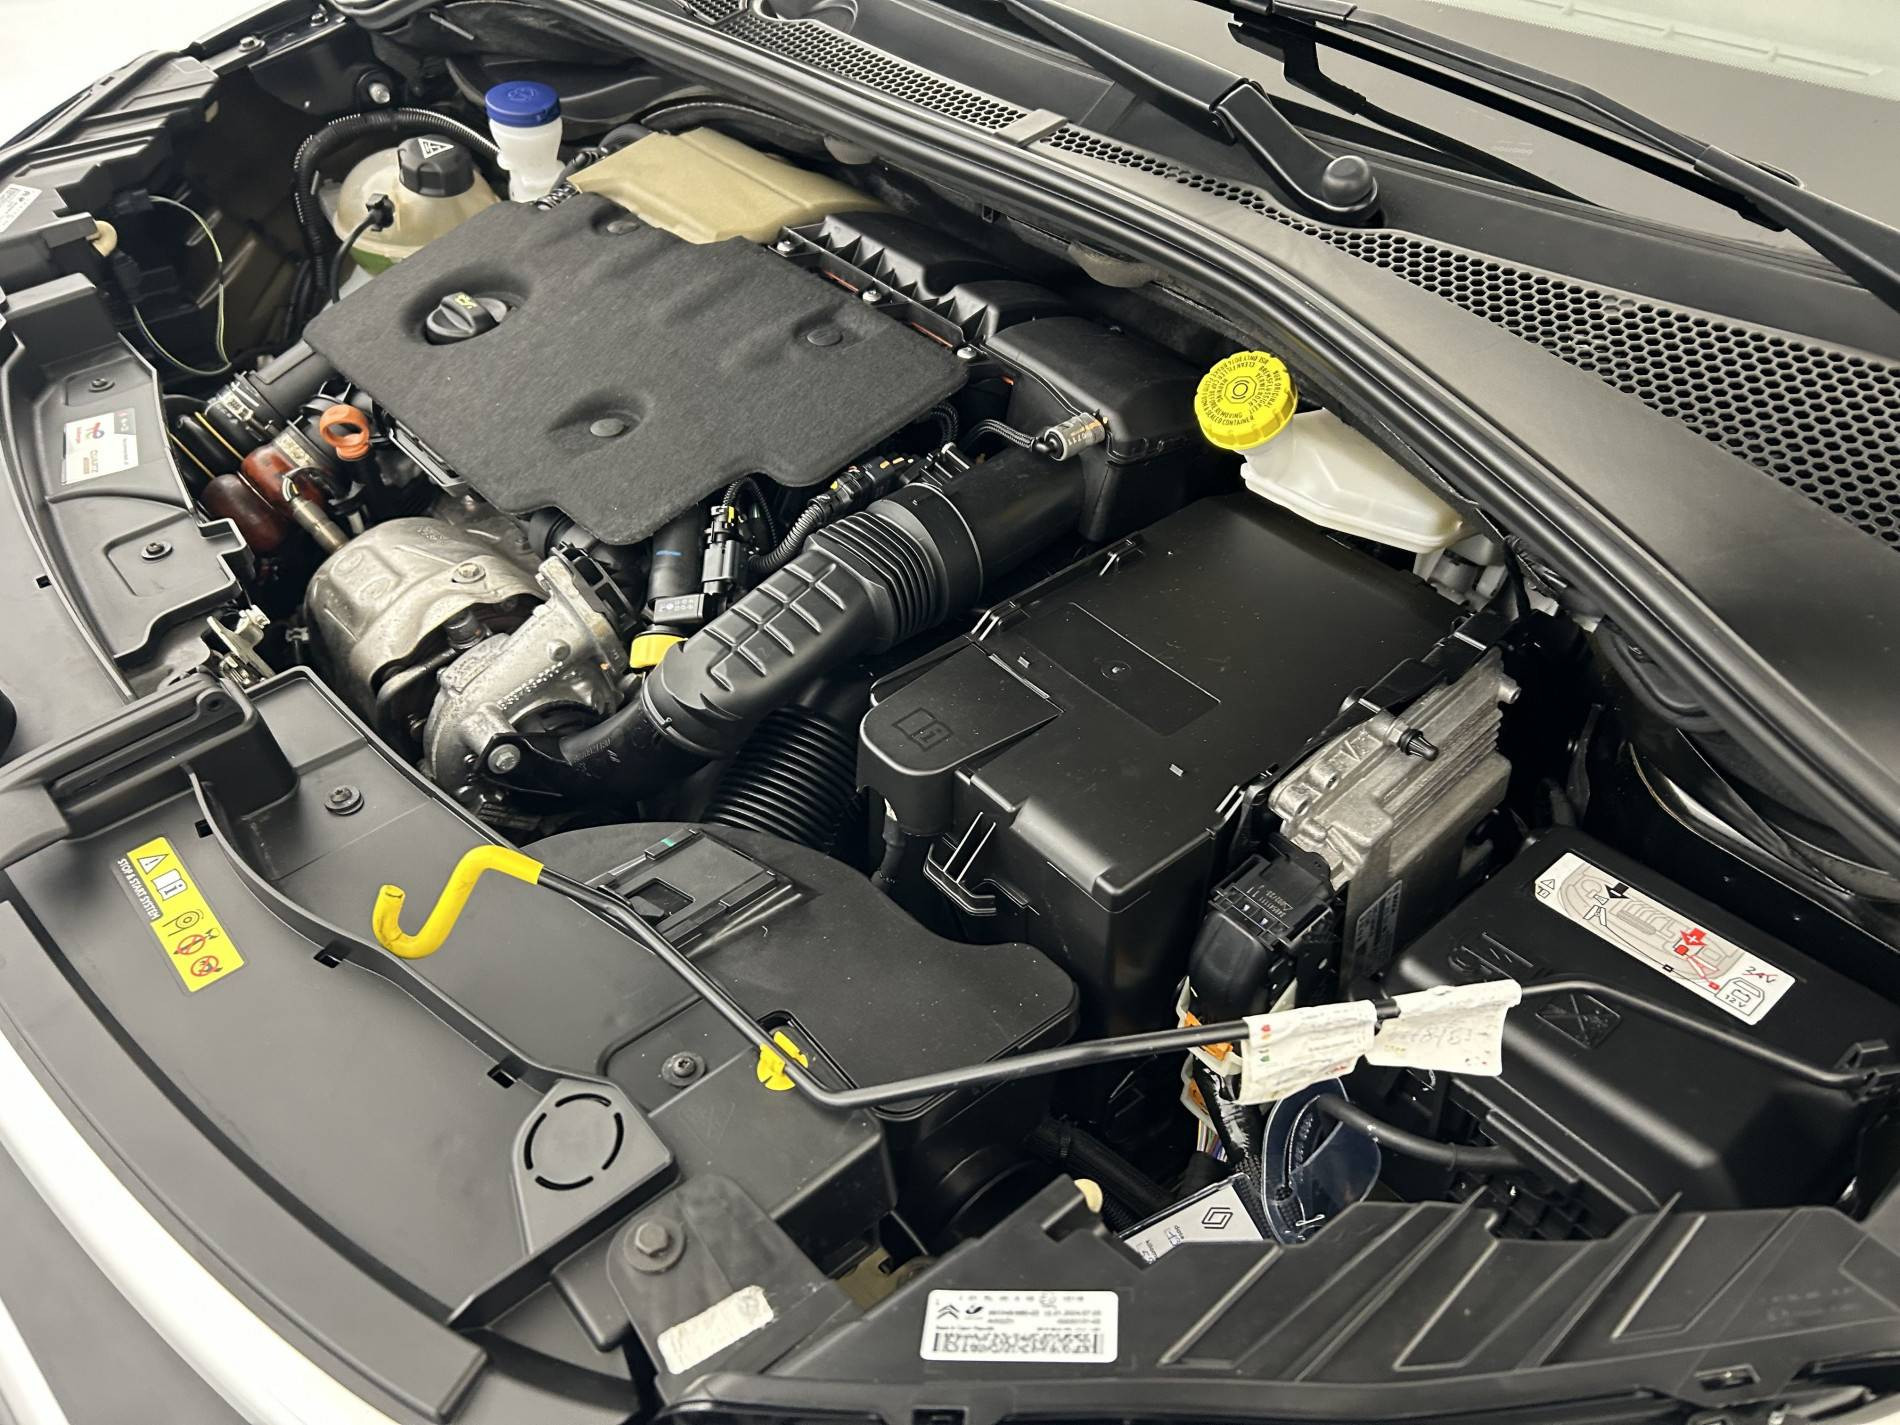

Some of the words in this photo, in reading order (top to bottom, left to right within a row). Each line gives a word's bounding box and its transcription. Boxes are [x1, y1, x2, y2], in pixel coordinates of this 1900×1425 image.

[1259, 356, 1270, 365] USE
[1207, 410, 1222, 423] SEALED
[1215, 407, 1243, 419] REMOVING
[1222, 414, 1254, 426] CONTAINER
[117, 858, 133, 874] STOP
[129, 878, 147, 898] START
[139, 895, 161, 920] SYSTEM
